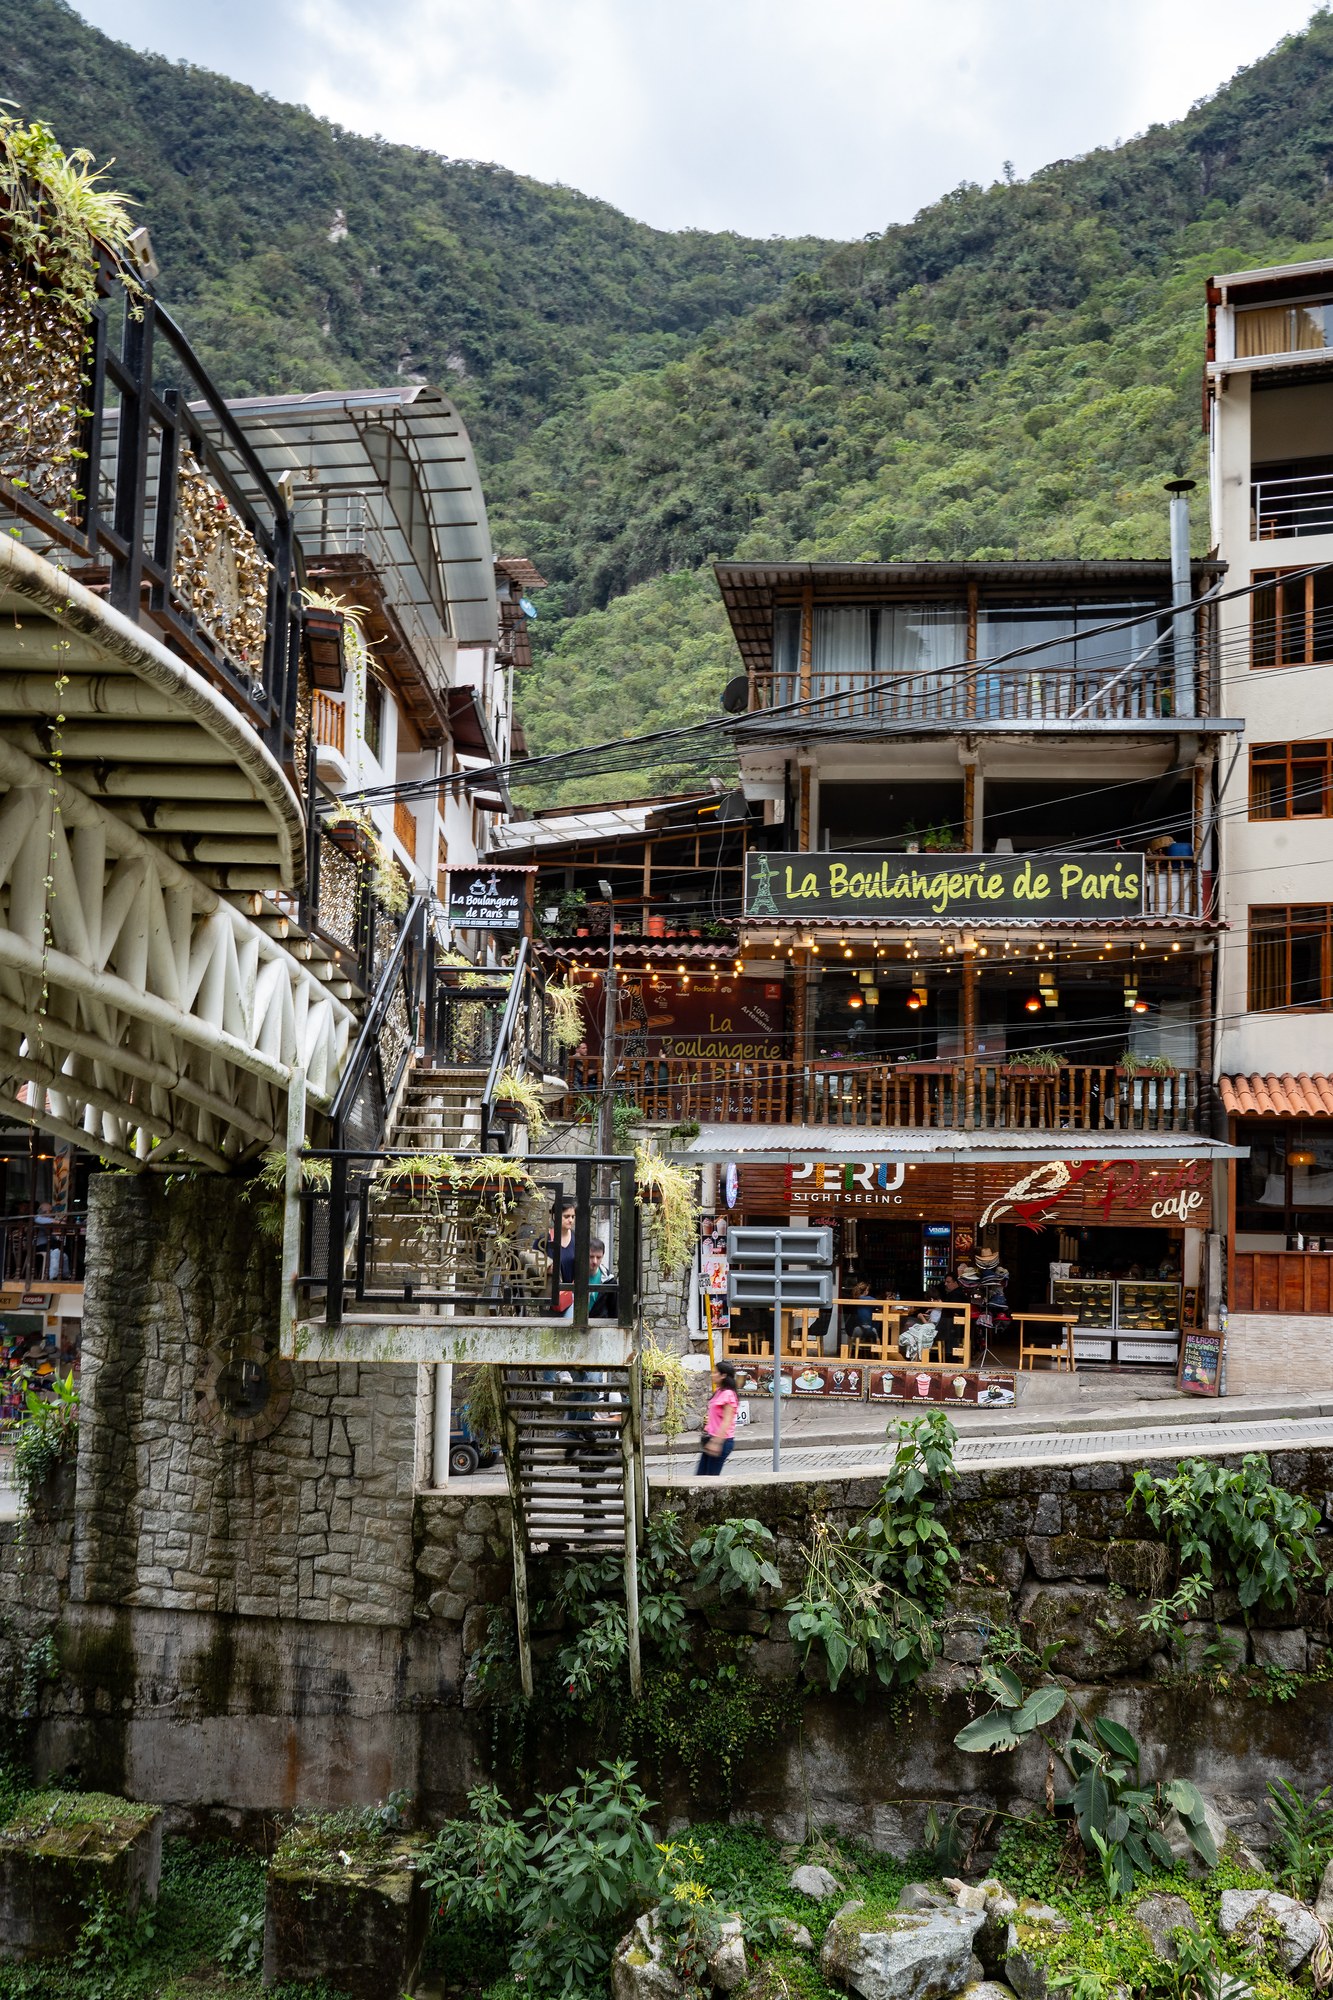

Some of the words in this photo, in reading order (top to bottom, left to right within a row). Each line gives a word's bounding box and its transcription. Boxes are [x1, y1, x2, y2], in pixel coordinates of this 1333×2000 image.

[785, 865, 820, 899] La
[829, 861, 1005, 914] Boulangerie
[1013, 861, 1051, 900] de
[1060, 862, 1140, 900] Paris
[451, 893, 464, 905] La
[466, 895, 519, 908] Boulangerie
[466, 906, 478, 918] de
[741, 1005, 773, 1033] Artesanal
[753, 1005, 770, 1022] 100%
[709, 1013, 734, 1033] La
[794, 1192, 903, 1204] SIGHTSEEING
[1151, 1190, 1203, 1222] cafe
[1187, 1335, 1220, 1346] HELADOS
